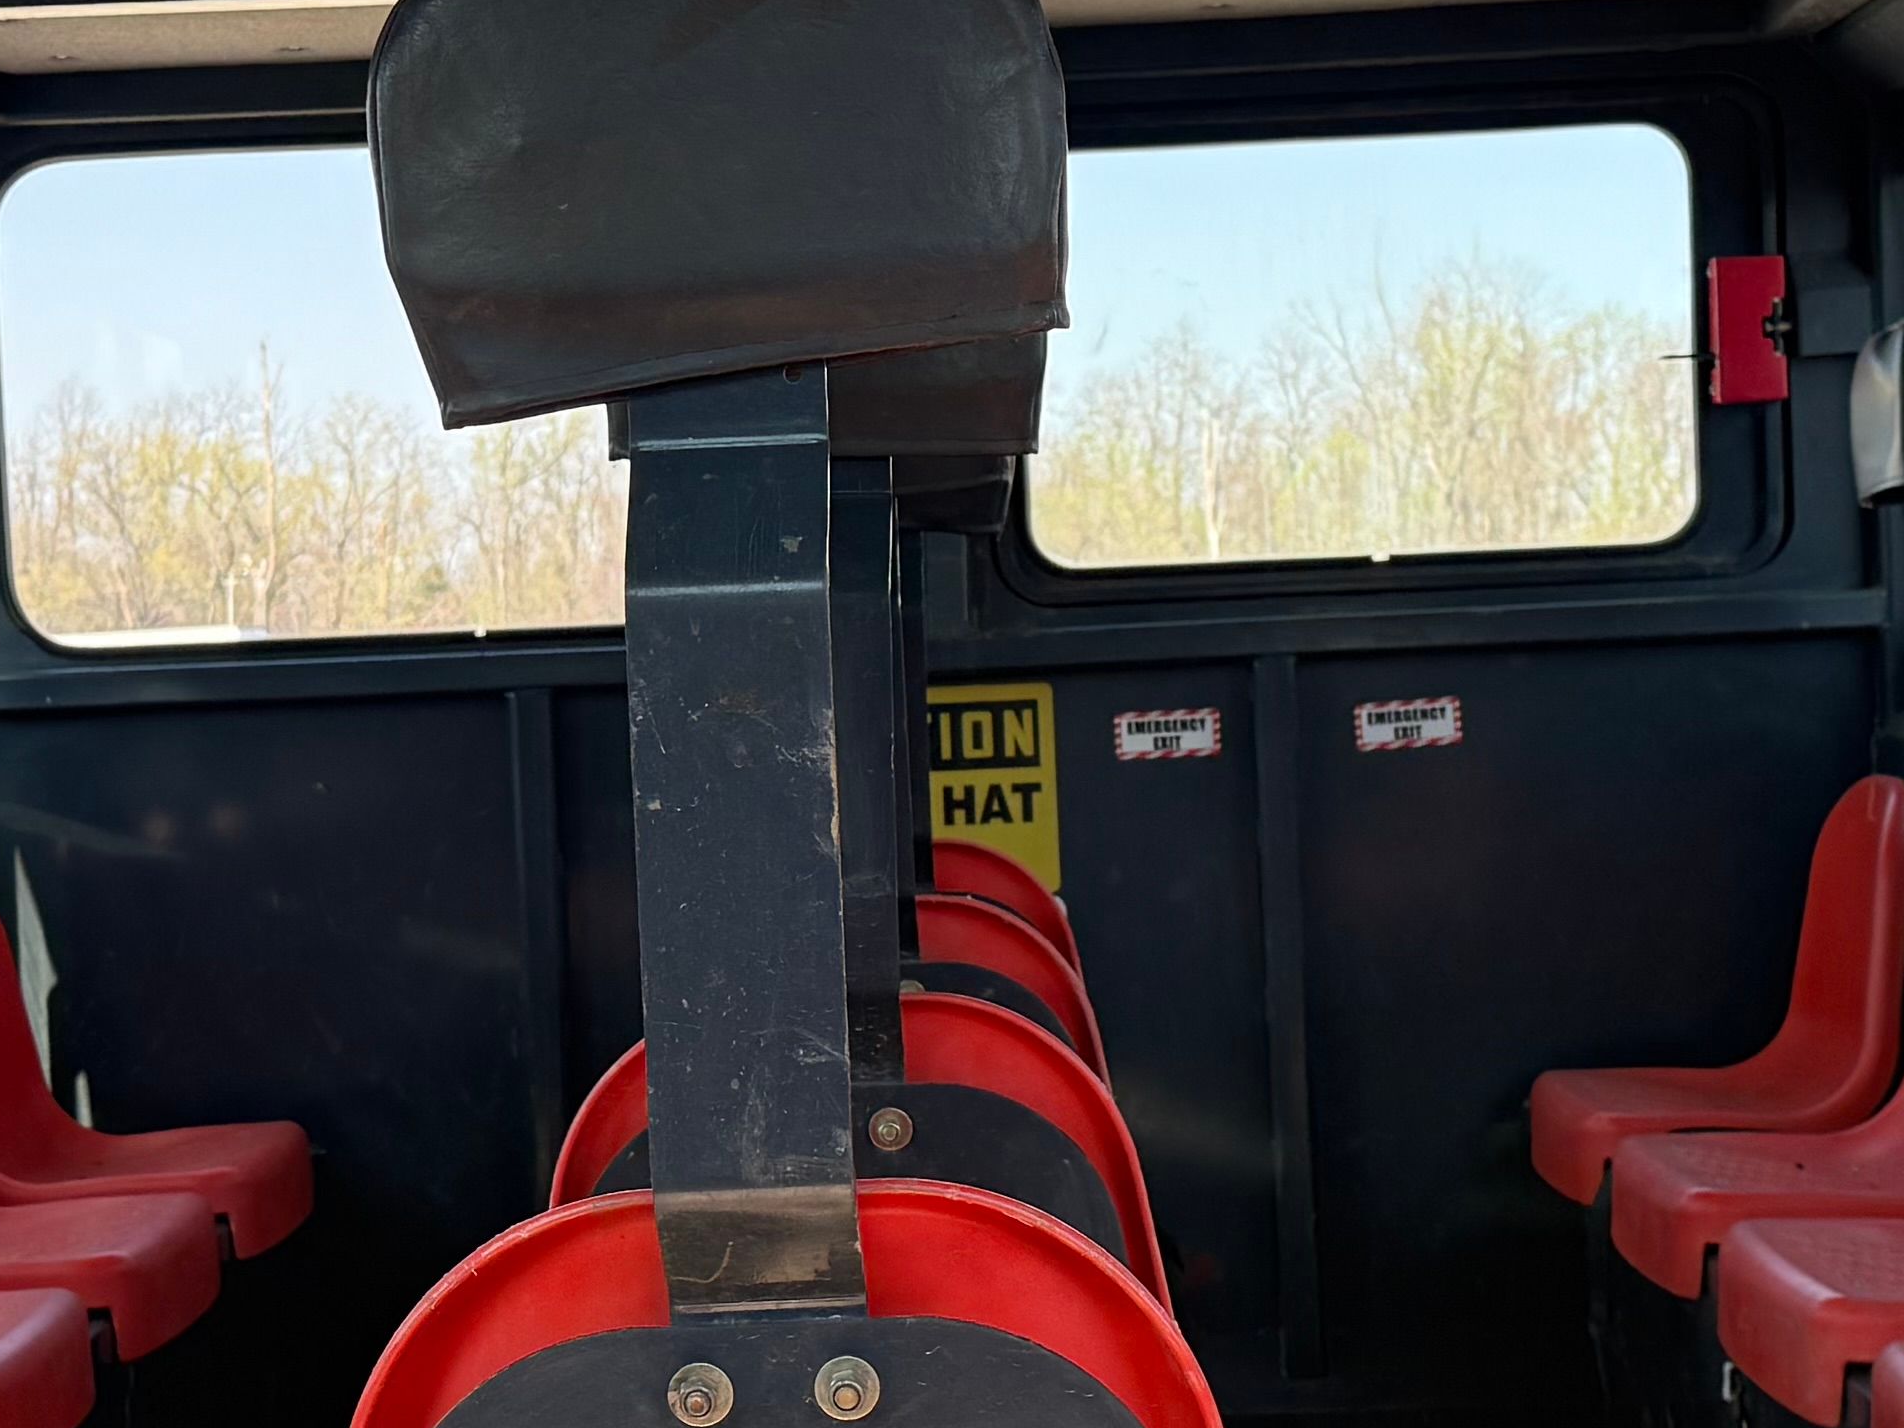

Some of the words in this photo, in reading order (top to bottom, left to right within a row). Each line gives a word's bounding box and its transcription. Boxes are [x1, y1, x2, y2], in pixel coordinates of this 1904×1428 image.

[1367, 706, 1446, 726] EMERGENCY
[927, 708, 1035, 760] ION
[1127, 718, 1205, 735] EMERGENCY
[1394, 724, 1422, 740] EXIT
[1153, 735, 1181, 751] EXIT
[943, 783, 1042, 825] HAT
